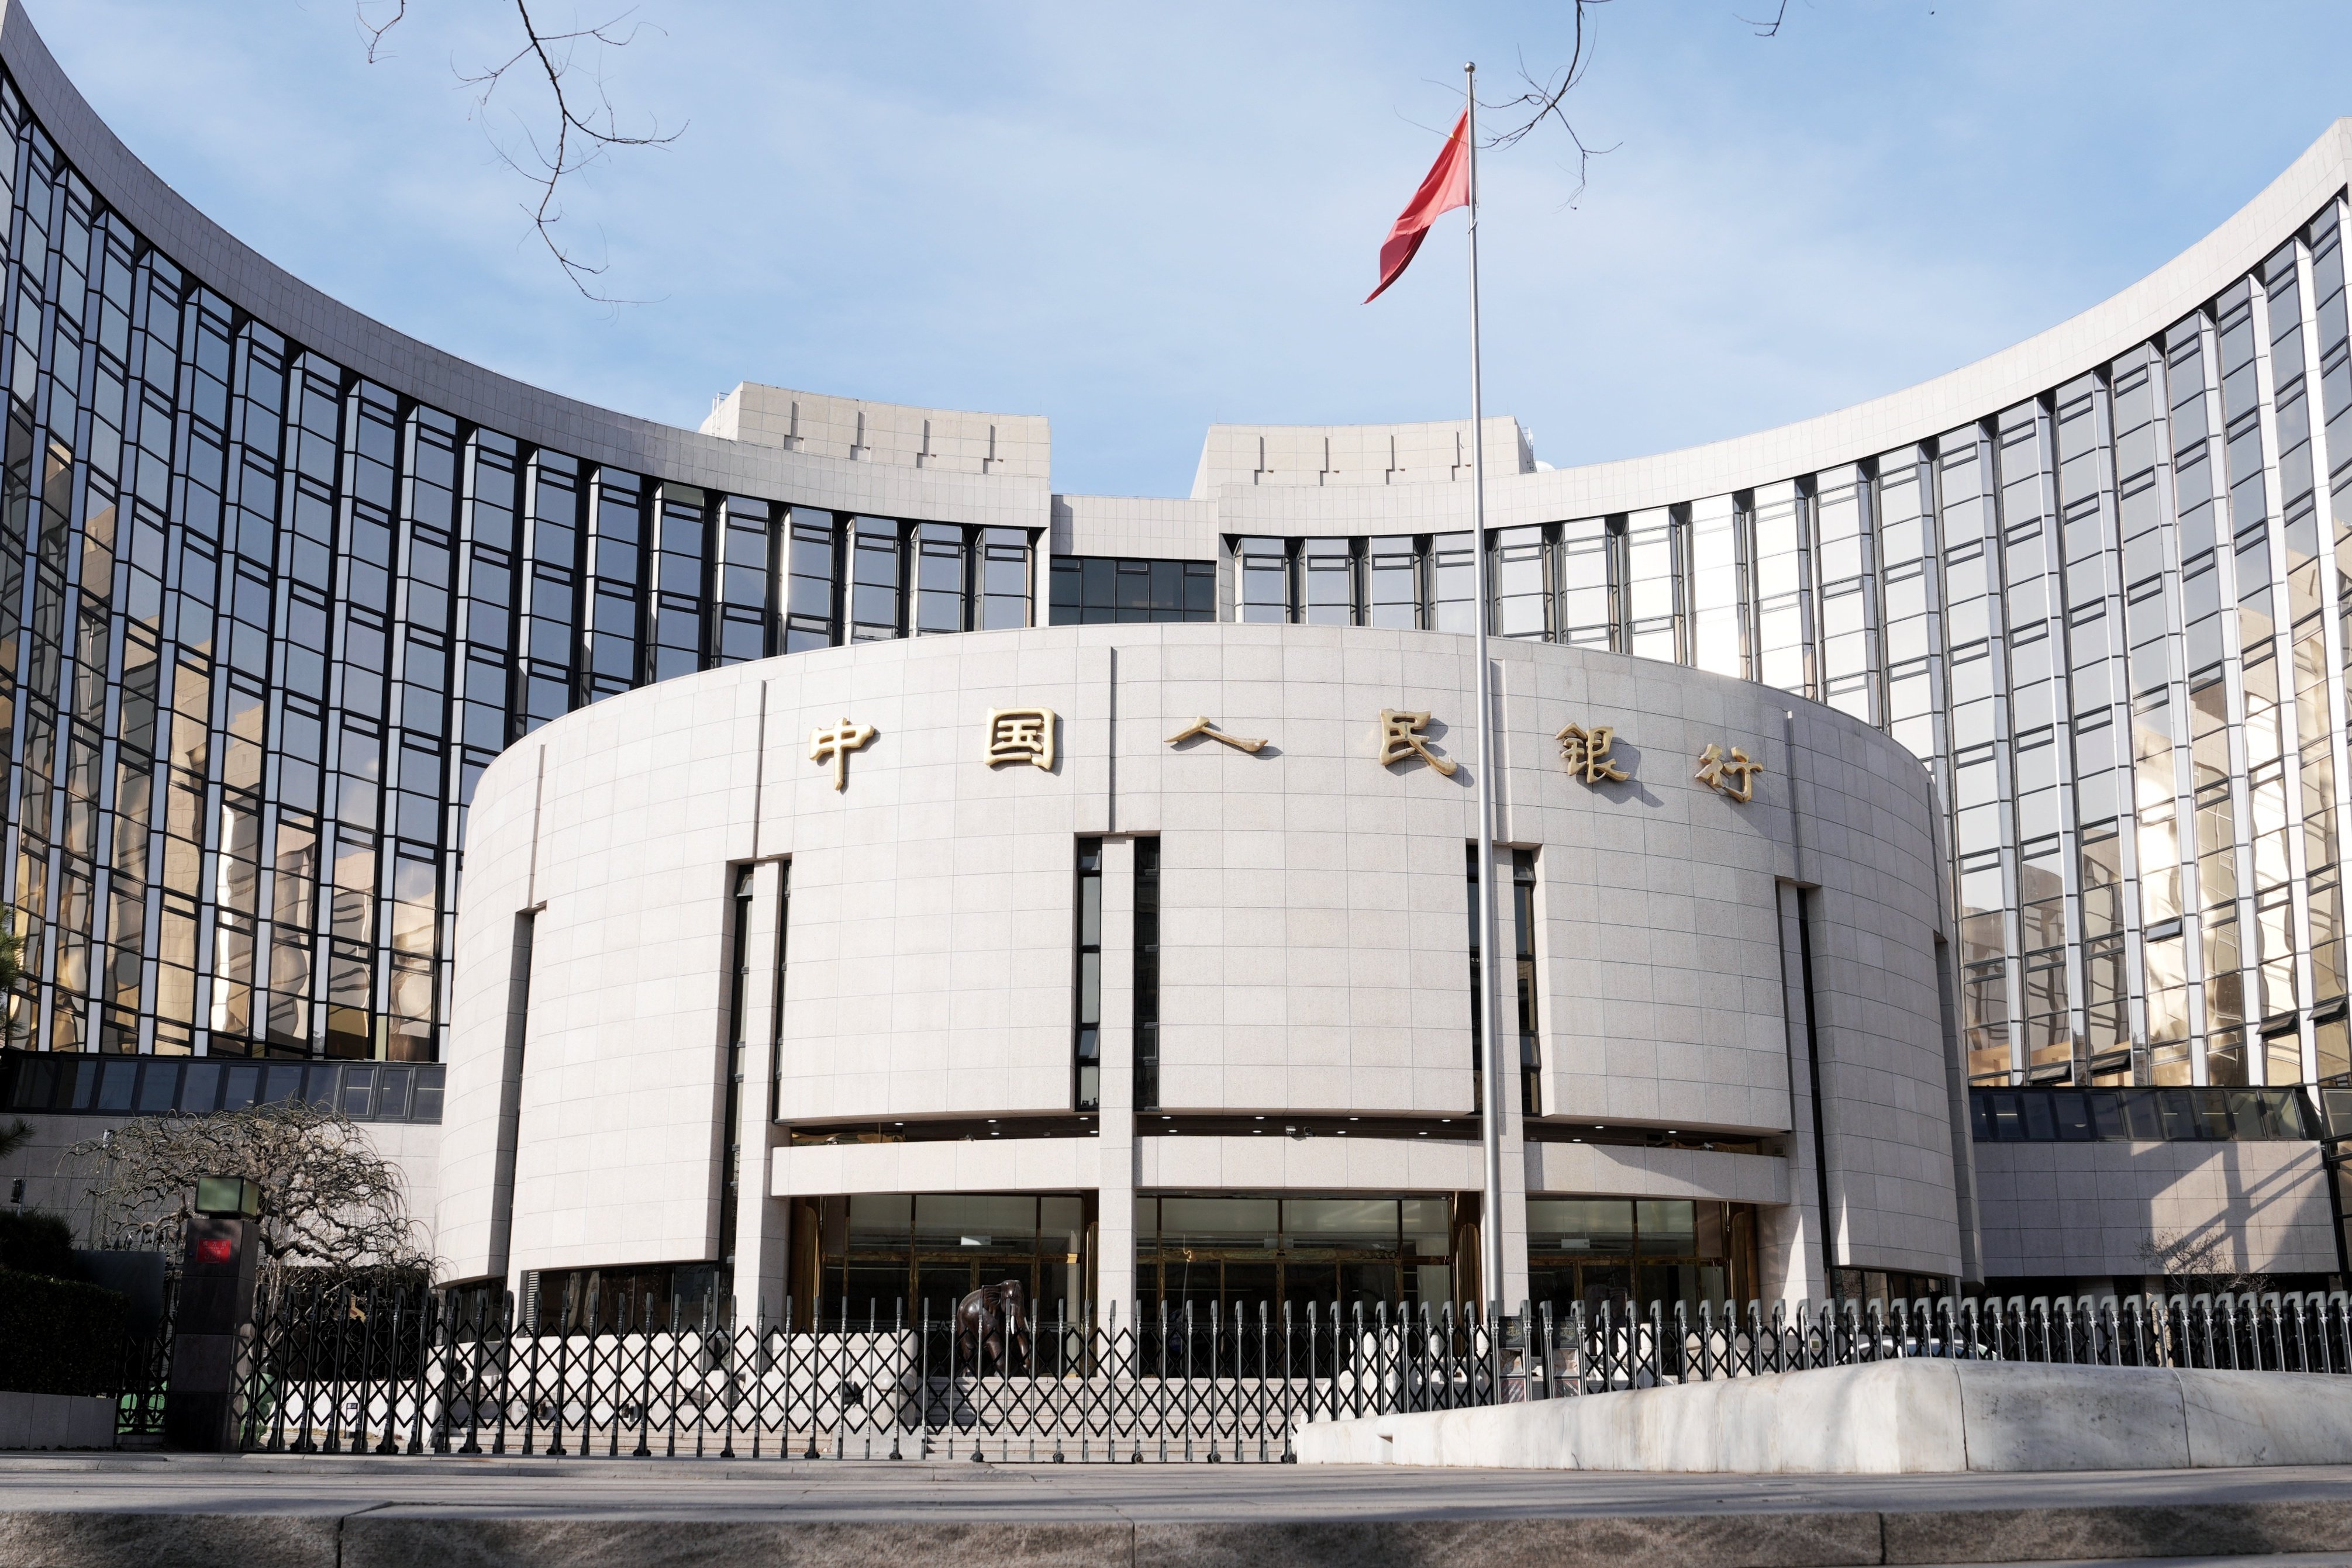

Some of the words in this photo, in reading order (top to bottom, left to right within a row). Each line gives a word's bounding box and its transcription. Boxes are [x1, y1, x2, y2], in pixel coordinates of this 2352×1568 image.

[809, 707, 1763, 803] 中国人民银行
